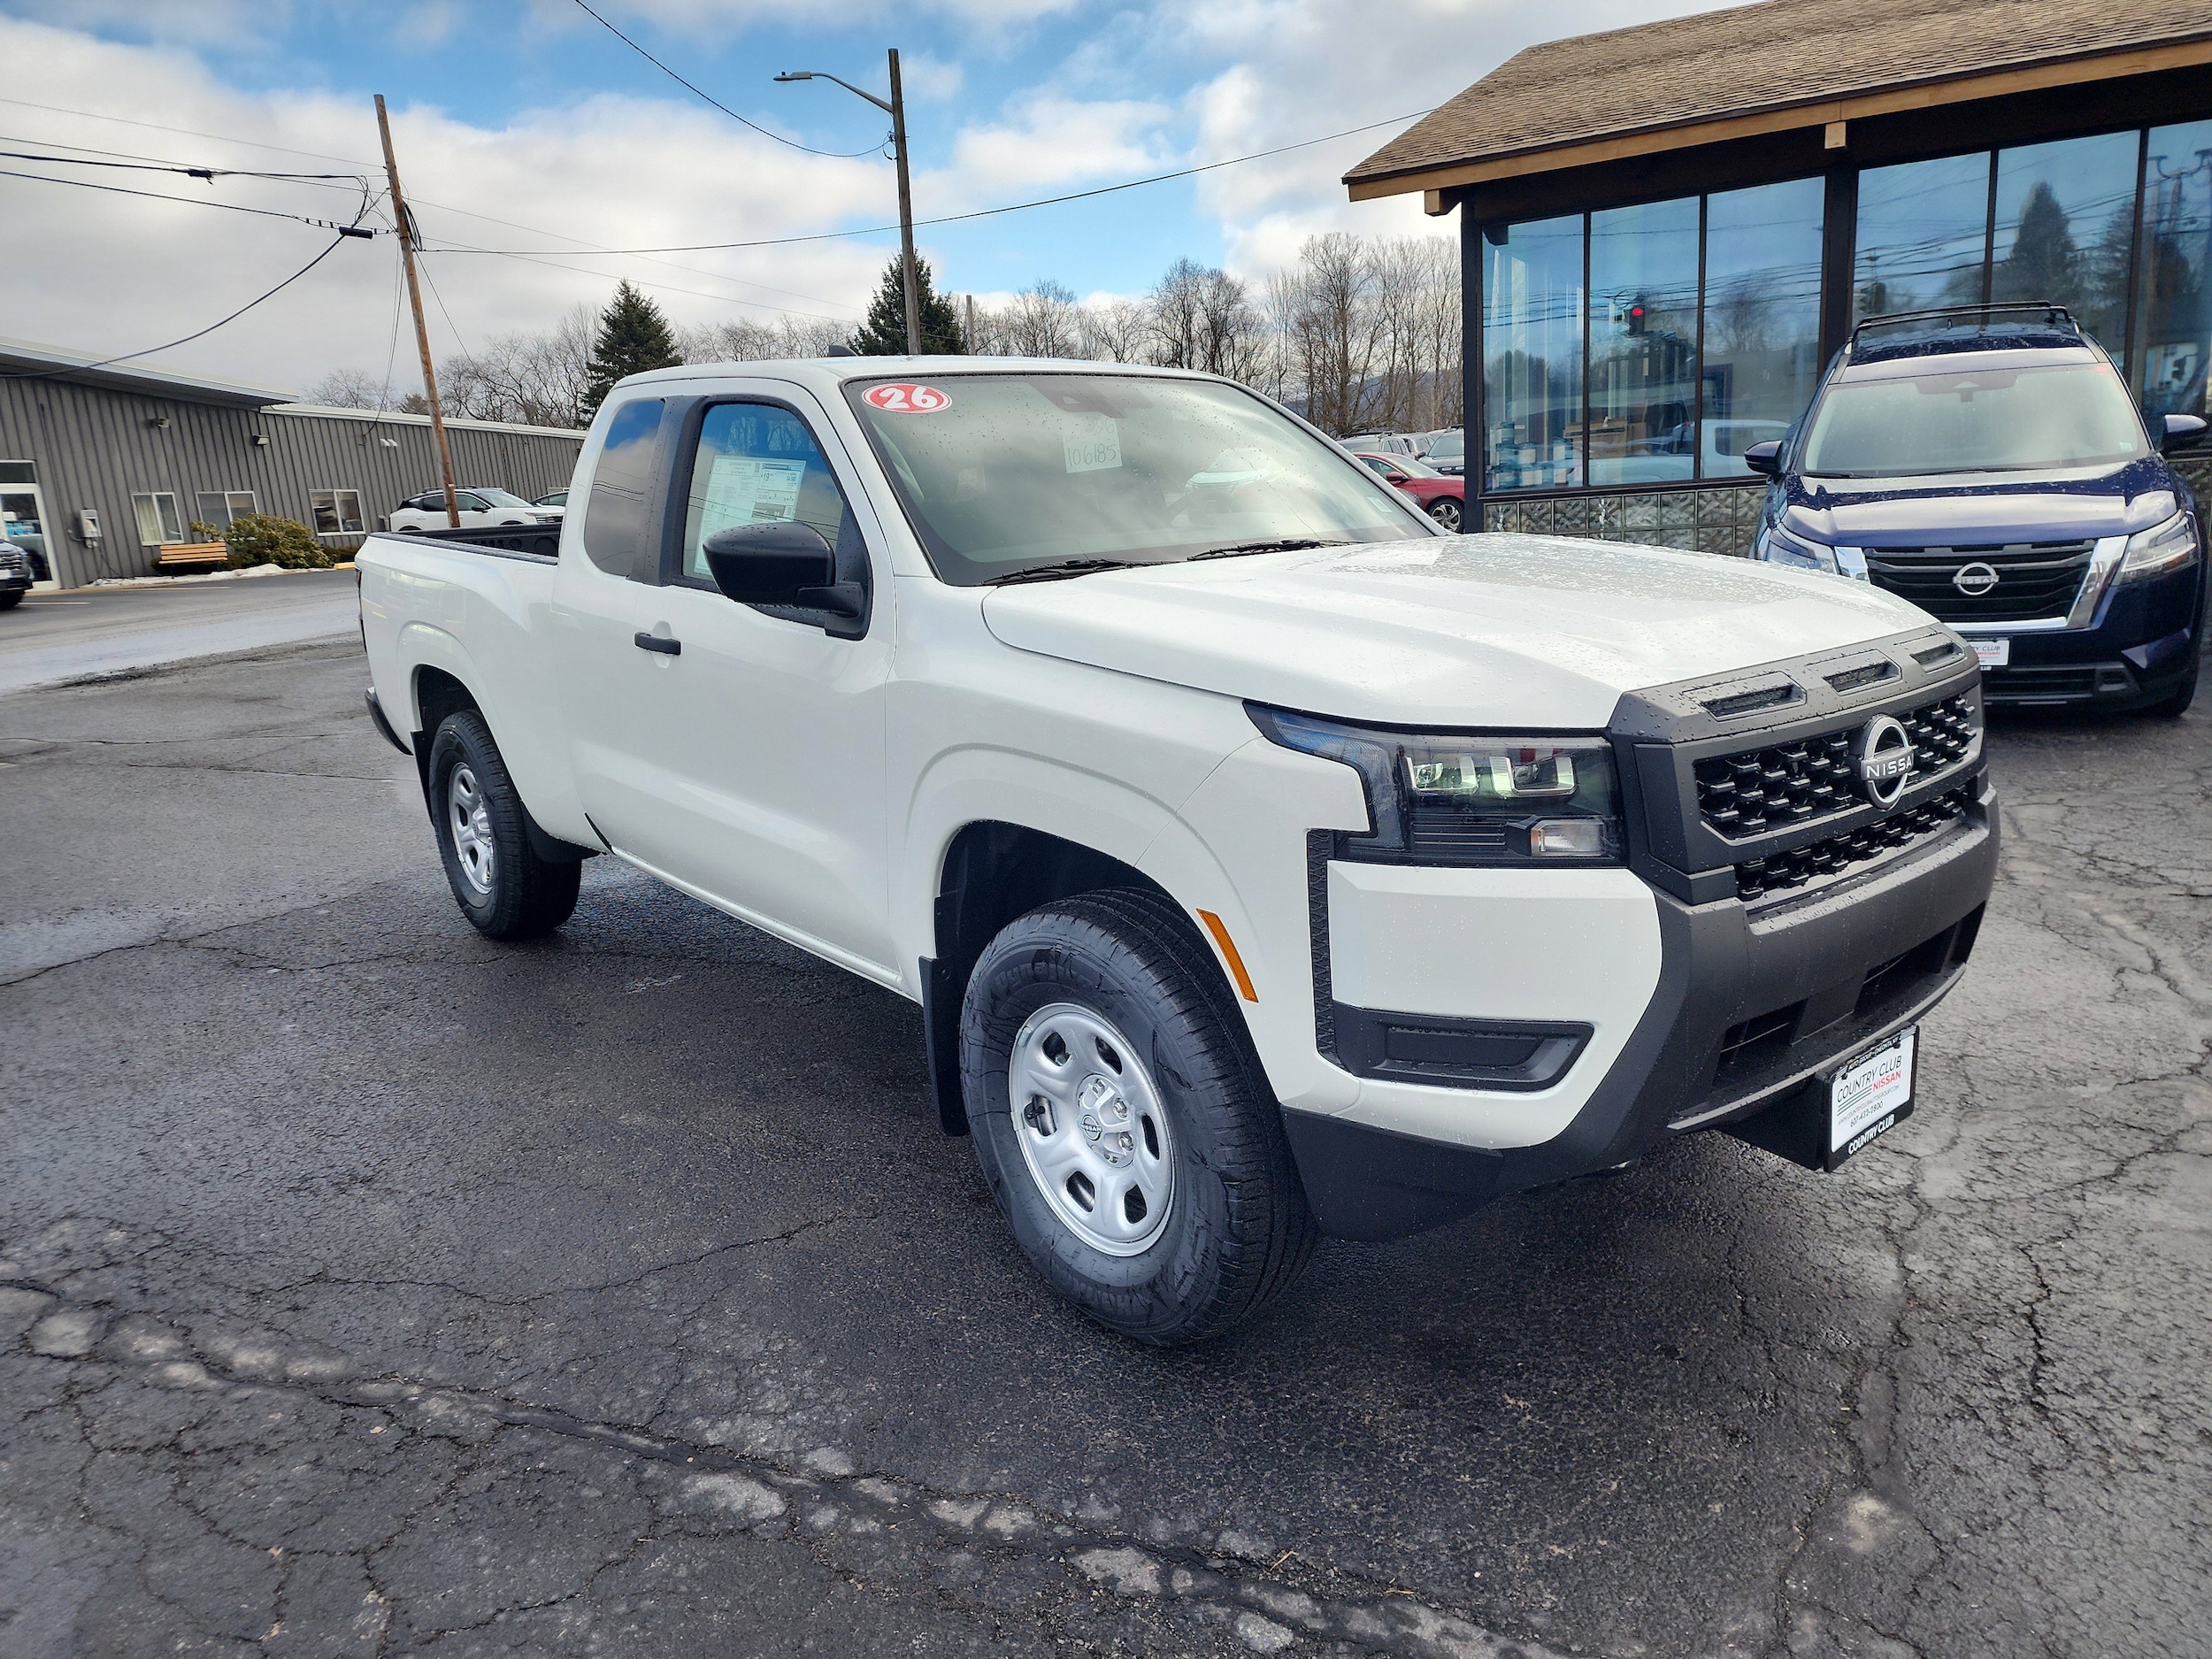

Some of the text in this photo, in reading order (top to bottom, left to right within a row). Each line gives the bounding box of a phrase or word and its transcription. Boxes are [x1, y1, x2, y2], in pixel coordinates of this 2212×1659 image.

[878, 386, 939, 409] 26
[1067, 442, 1117, 468] 106185
[1837, 1055, 1902, 1102] COUNTRY CLUB
[1872, 1070, 1901, 1092] NISSAN
[1850, 1101, 1884, 1127] 607-432-2800
[1848, 1113, 1895, 1155] COUNTRY CLUB
